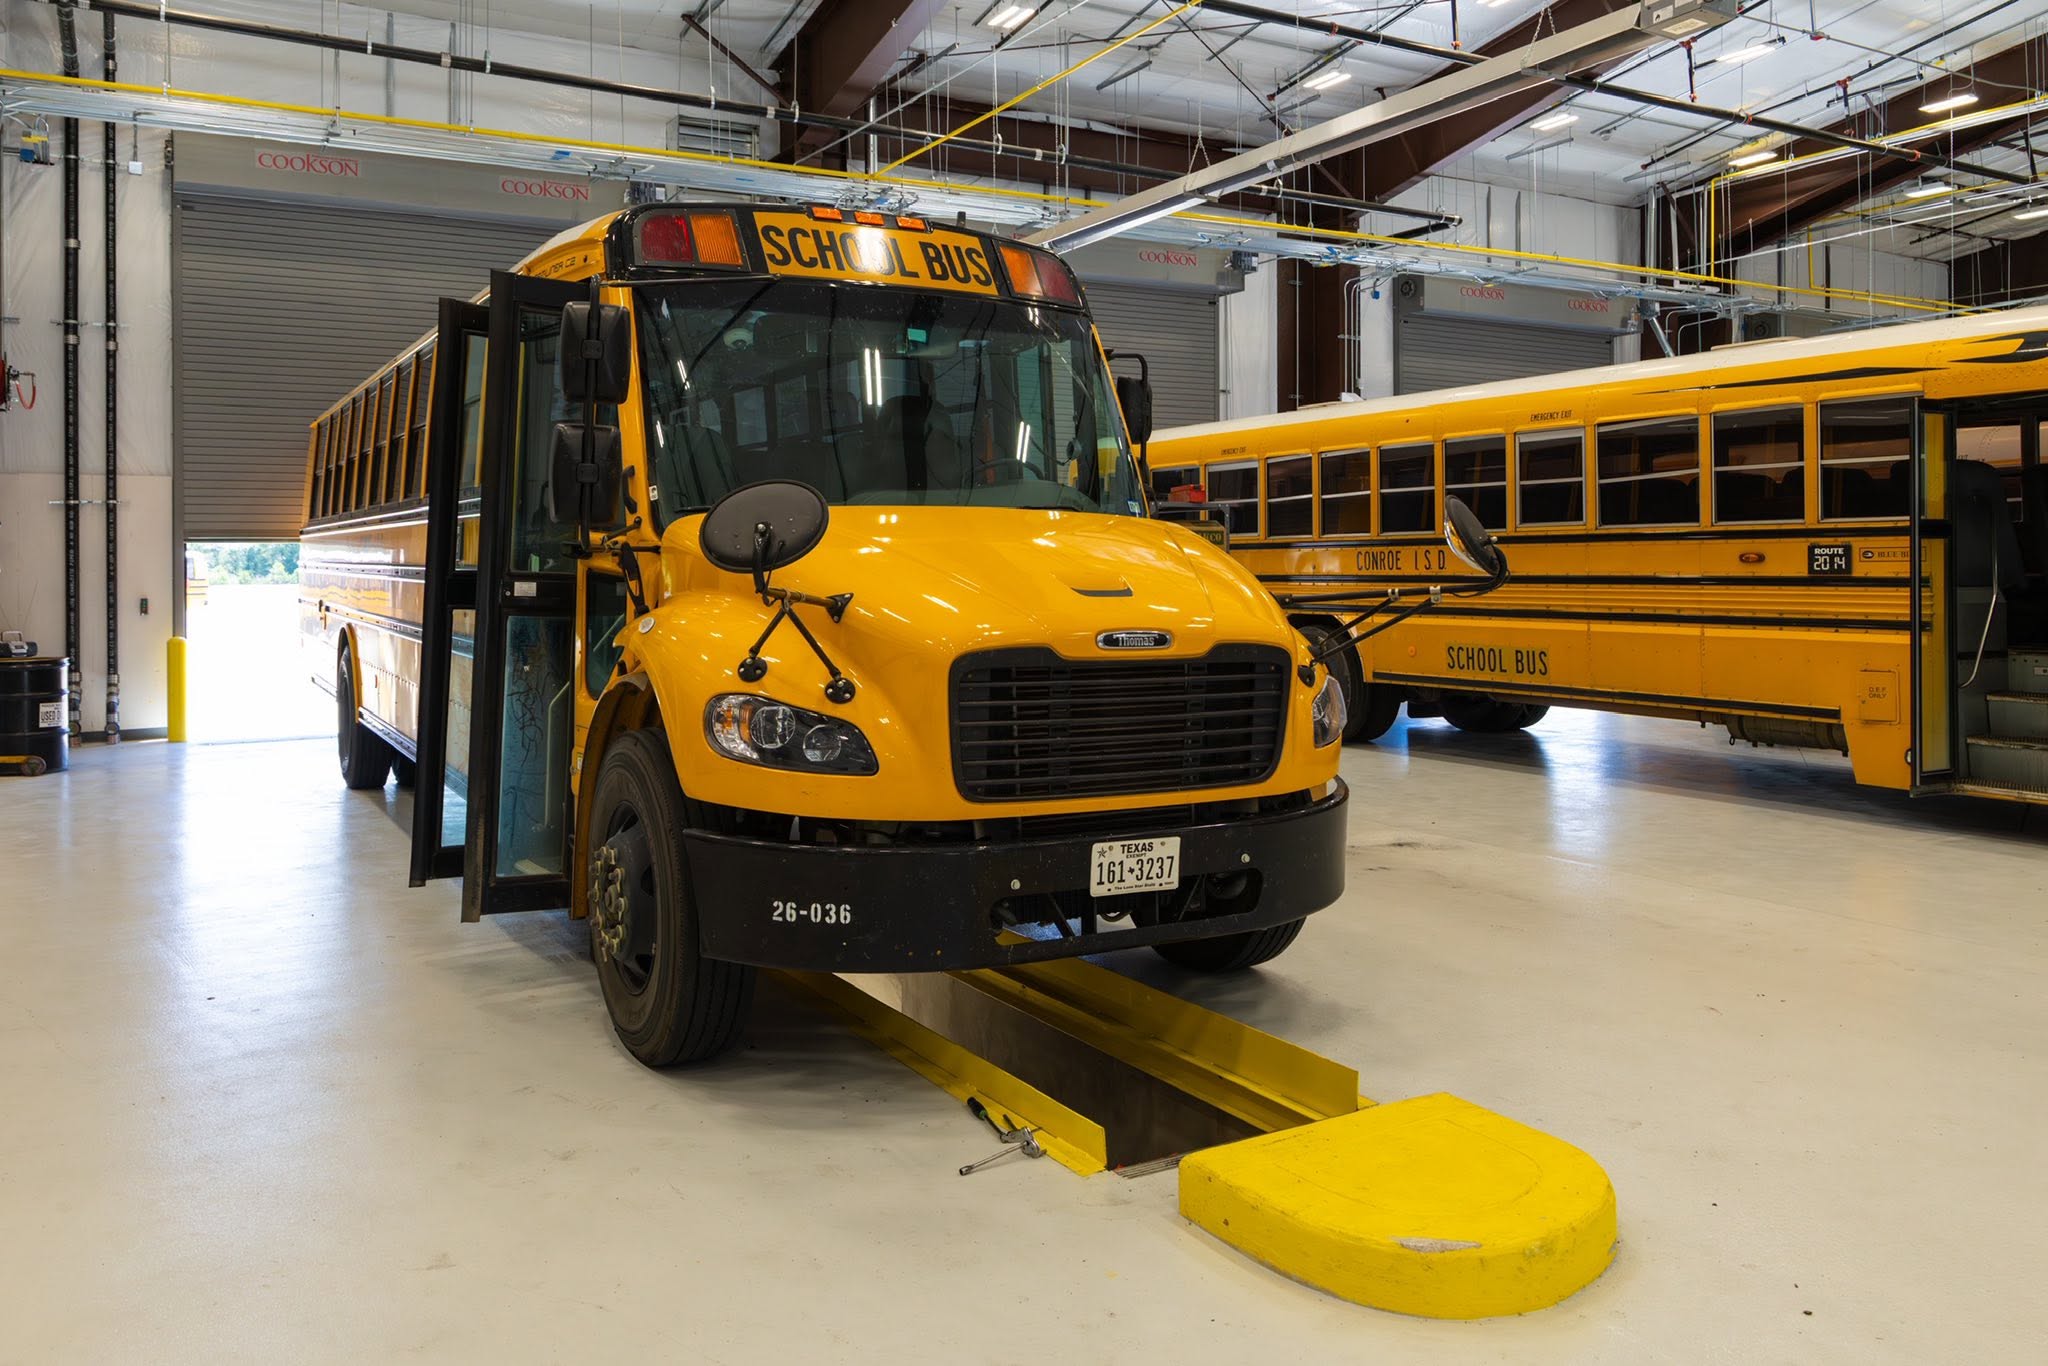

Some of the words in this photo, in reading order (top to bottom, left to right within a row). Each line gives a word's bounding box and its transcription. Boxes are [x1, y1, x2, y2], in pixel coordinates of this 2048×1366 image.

[258, 153, 359, 176] COOKSON
[501, 180, 589, 200] COOKSON
[761, 225, 920, 278] SCHOOL
[919, 241, 993, 287] BUS
[1139, 251, 1197, 266] COOKSON
[1460, 286, 1505, 300] COOKSON
[1568, 299, 1609, 312] COOKSON
[1814, 547, 1845, 555] ROUTE
[1356, 550, 1402, 571] CONROE
[1113, 633, 1159, 647] Thomas
[1447, 646, 1507, 673] SCHOOL
[1515, 650, 1548, 675] BUS
[41, 711, 56, 721] USED
[1120, 842, 1154, 854] TEXAS
[772, 900, 851, 924] 26-036
